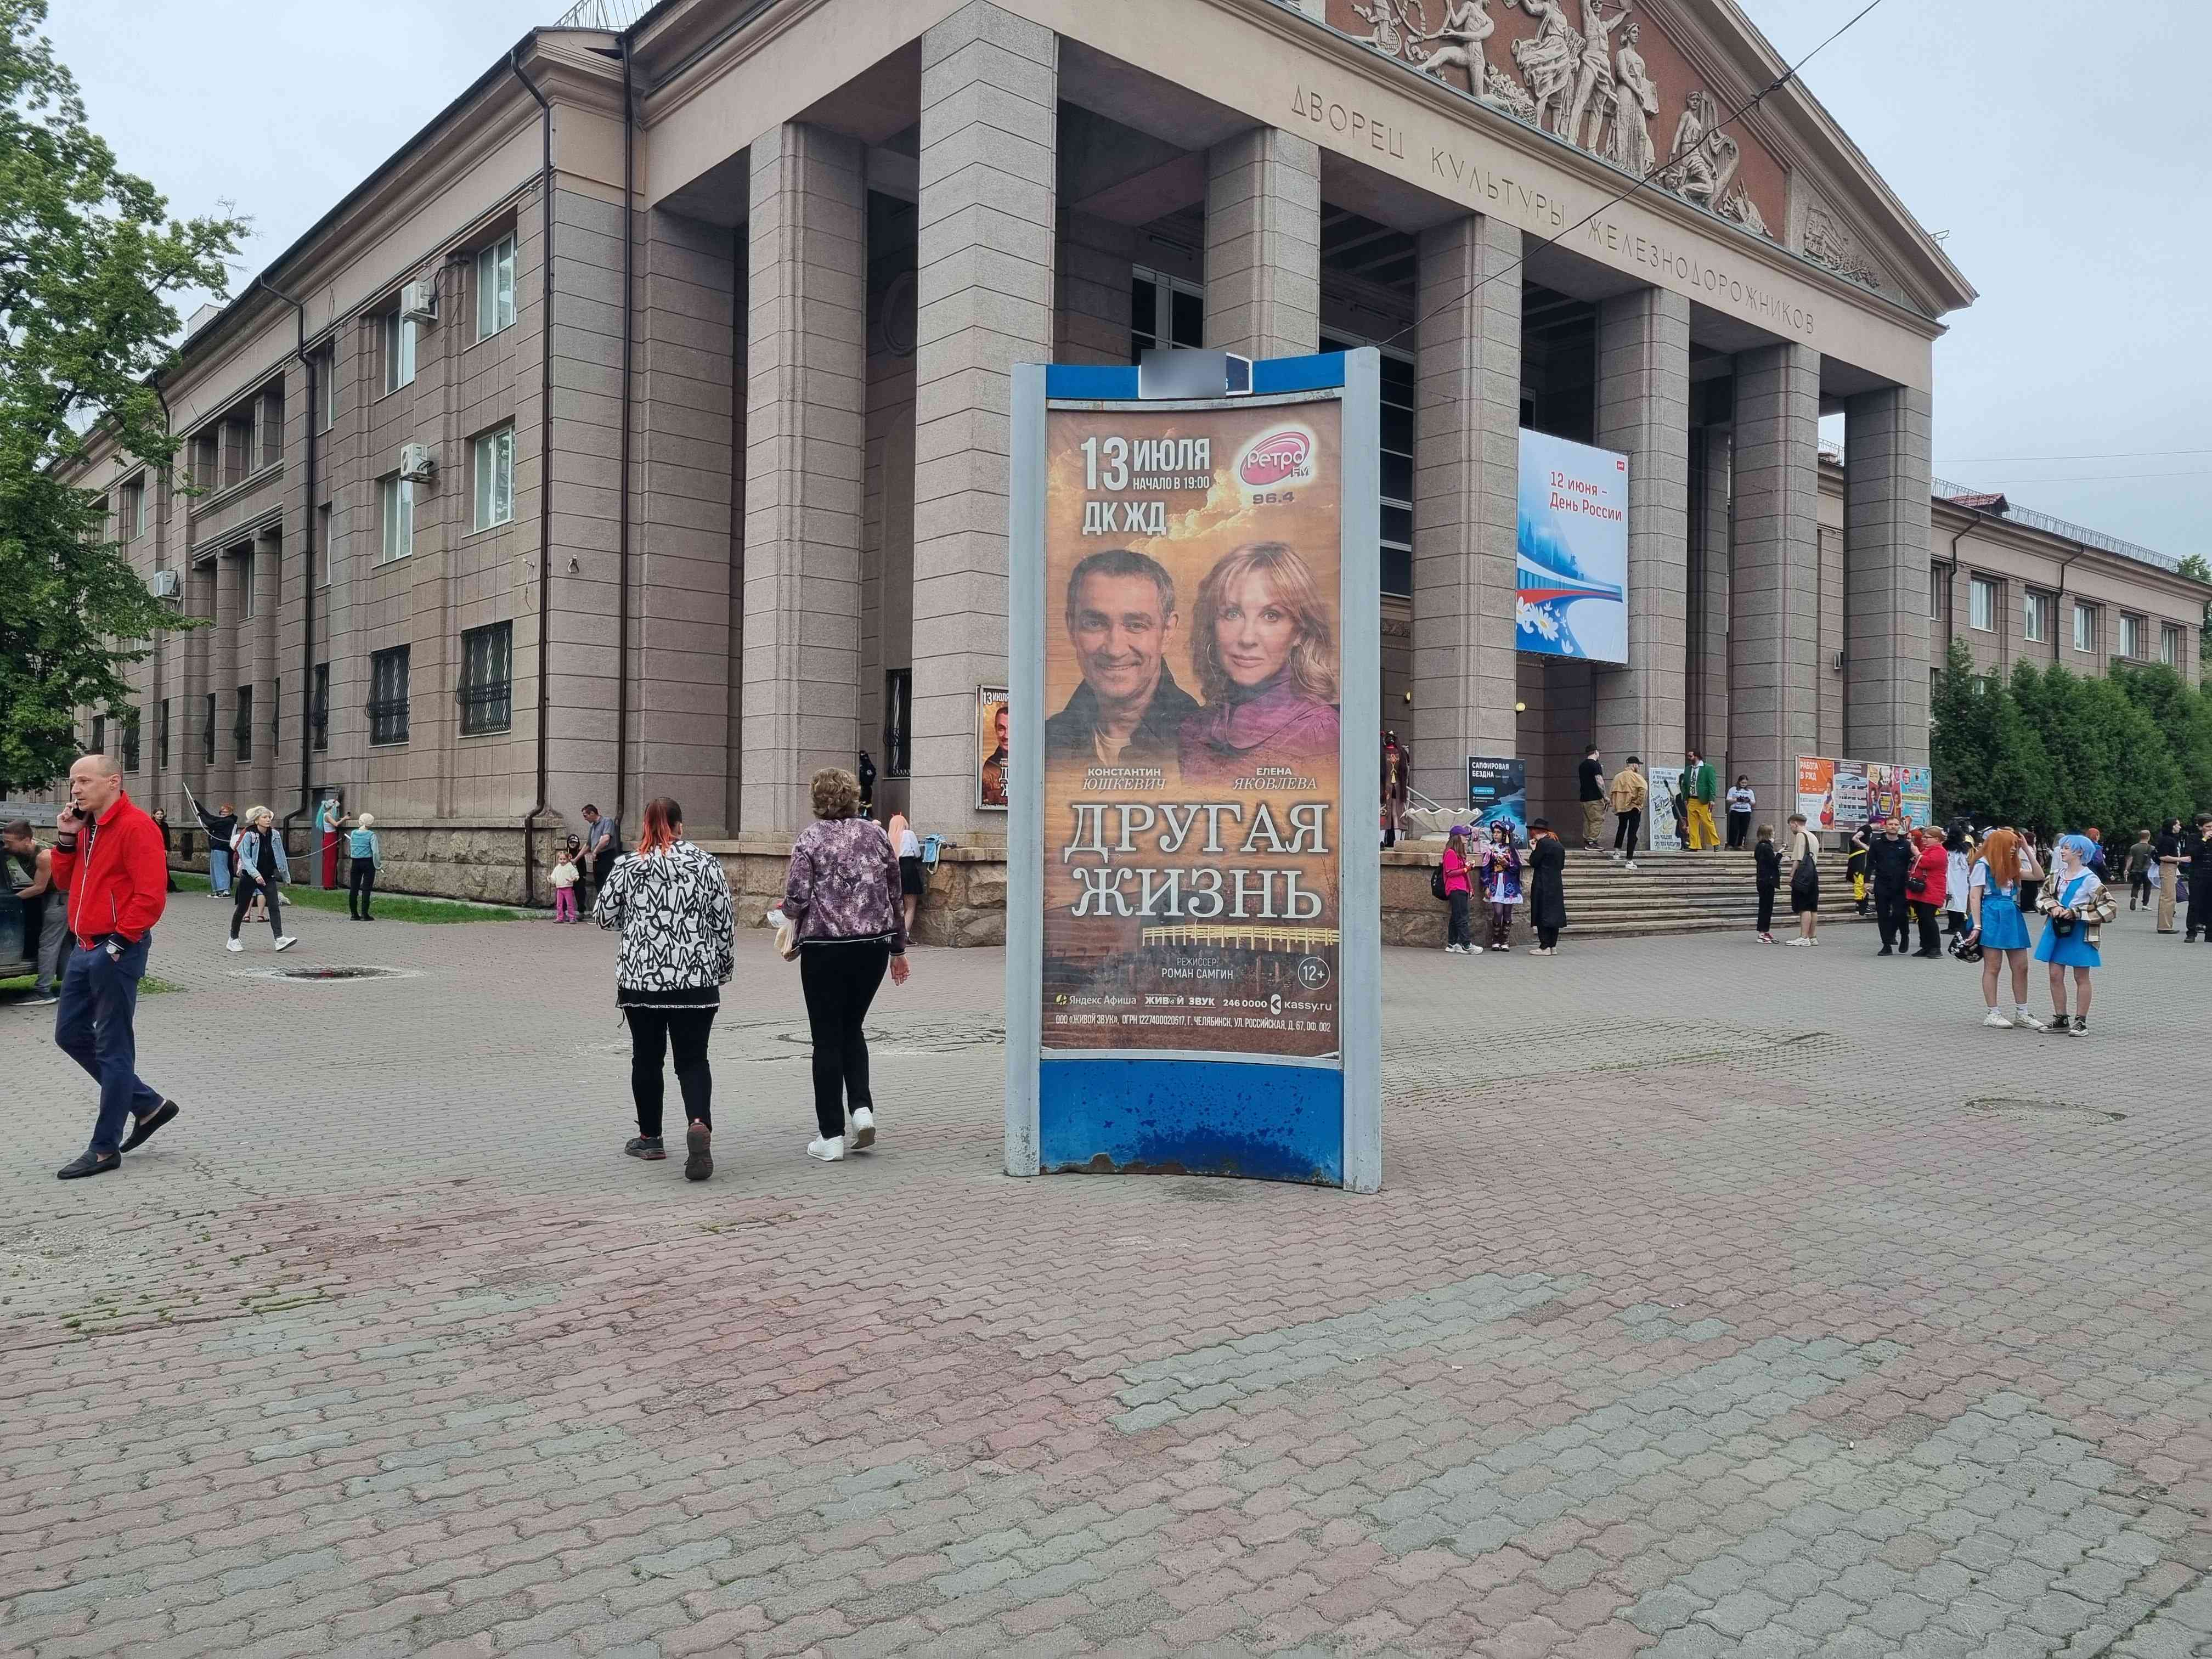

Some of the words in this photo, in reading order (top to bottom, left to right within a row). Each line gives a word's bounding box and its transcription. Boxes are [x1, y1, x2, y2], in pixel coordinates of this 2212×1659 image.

[1291, 84, 1403, 159] ДВОРЕЦ
[1432, 146, 1565, 229] КУЛЬТУРЫ
[1587, 217, 1814, 334] ЖЕЛЕЗНОДОРОЖНИКОВ
[1081, 437, 1128, 490] 13
[1133, 438, 1210, 471] ИЮЛЯ
[1290, 466, 1310, 477] FM
[1133, 477, 1172, 490] НАЧАЛО
[1174, 477, 1181, 490] В
[1184, 476, 1210, 489] 19:00
[1550, 471, 1564, 488] 12
[1568, 479, 1598, 496] июня
[1252, 492, 1295, 505] 96.4
[1550, 492, 1578, 512] День
[1583, 499, 1622, 522] России
[1082, 501, 1119, 535] ДК
[1123, 501, 1167, 535] ЖД
[983, 691, 992, 705] 13
[1087, 768, 1161, 776] КОНСТАНТИН
[1256, 768, 1292, 776] ЕЛЕНА
[1471, 761, 1509, 771] САПФИРОВАЯ
[1472, 770, 1494, 779] БЕЗДНА
[1082, 777, 1167, 791] ЮШКЕВИЧ
[1232, 777, 1317, 790] ЯКОВЛЕВА
[1064, 804, 1329, 864] ДРУГАЯ
[1071, 867, 1323, 919] ЖИЗНЬ
[1177, 957, 1217, 967] РЕЖИССЕР:
[1161, 968, 1194, 979] РОМАН
[1197, 969, 1233, 980] САМГИН
[1302, 965, 1325, 981] 12+
[1069, 995, 1102, 1006] Яндекс
[1104, 995, 1137, 1006] Афиша
[1188, 997, 1215, 1006] ЗВУК
[1223, 998, 1240, 1007] 246
[1242, 1000, 1268, 1008] 0000
[1284, 1000, 1332, 1013] kassy.ru
[1056, 1014, 1068, 1024] ООО
[1069, 1013, 1096, 1025] «ЖИВОЙ
[1097, 1014, 1120, 1025] ЗВУК»,
[1122, 1015, 1137, 1025] ОГРН
[1194, 1016, 1233, 1028] ЧЕЛЯБИНСК,
[1234, 1018, 1244, 1028] УЛ.
[1245, 1017, 1286, 1030] РОССИЙСКАЯ,
[1319, 1022, 1331, 1032] 002
